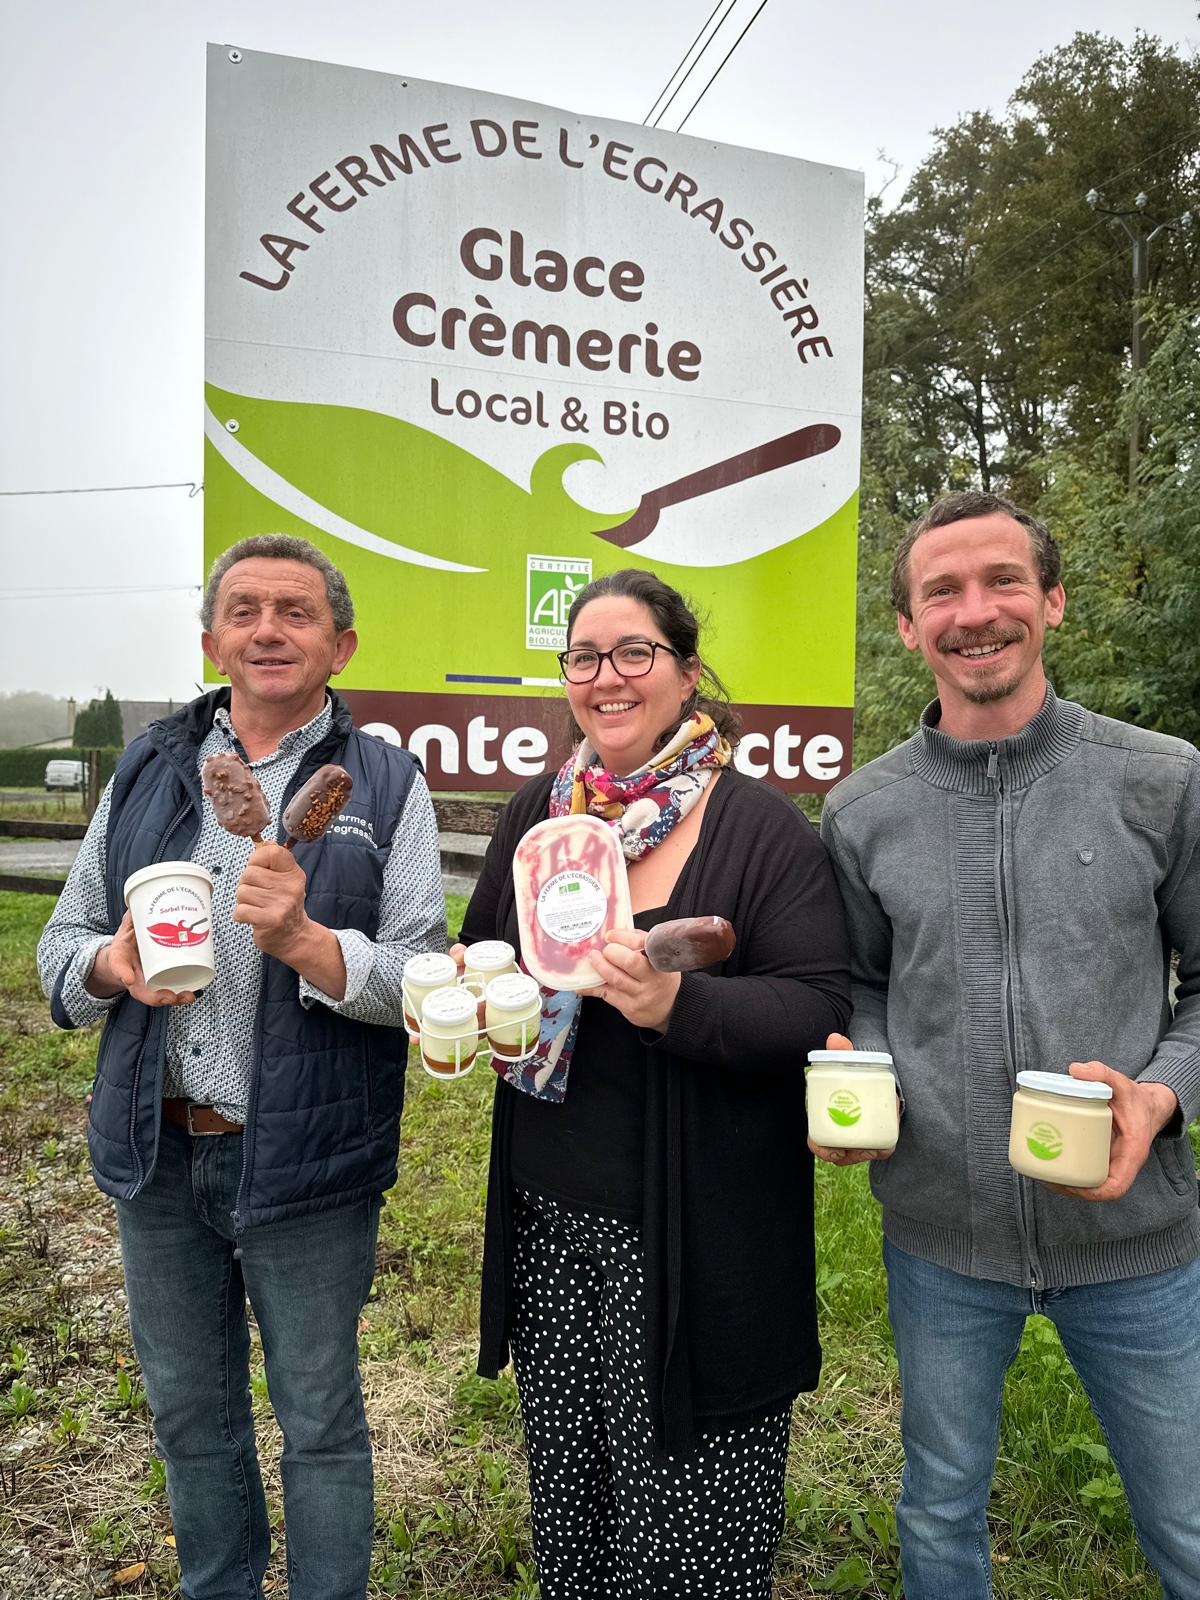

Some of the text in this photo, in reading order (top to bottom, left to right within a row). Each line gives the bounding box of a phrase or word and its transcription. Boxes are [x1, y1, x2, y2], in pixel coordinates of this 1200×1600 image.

[239, 233, 310, 291] LA
[286, 122, 462, 234] FERME
[469, 119, 543, 160] DE
[460, 227, 645, 302] Glace
[393, 292, 702, 382] Crèmerie
[430, 377, 670, 441] Local & Bio
[529, 627, 567, 637] AGRICUL
[529, 637, 566, 646] BIOLOG
[338, 814, 366, 826] erme
